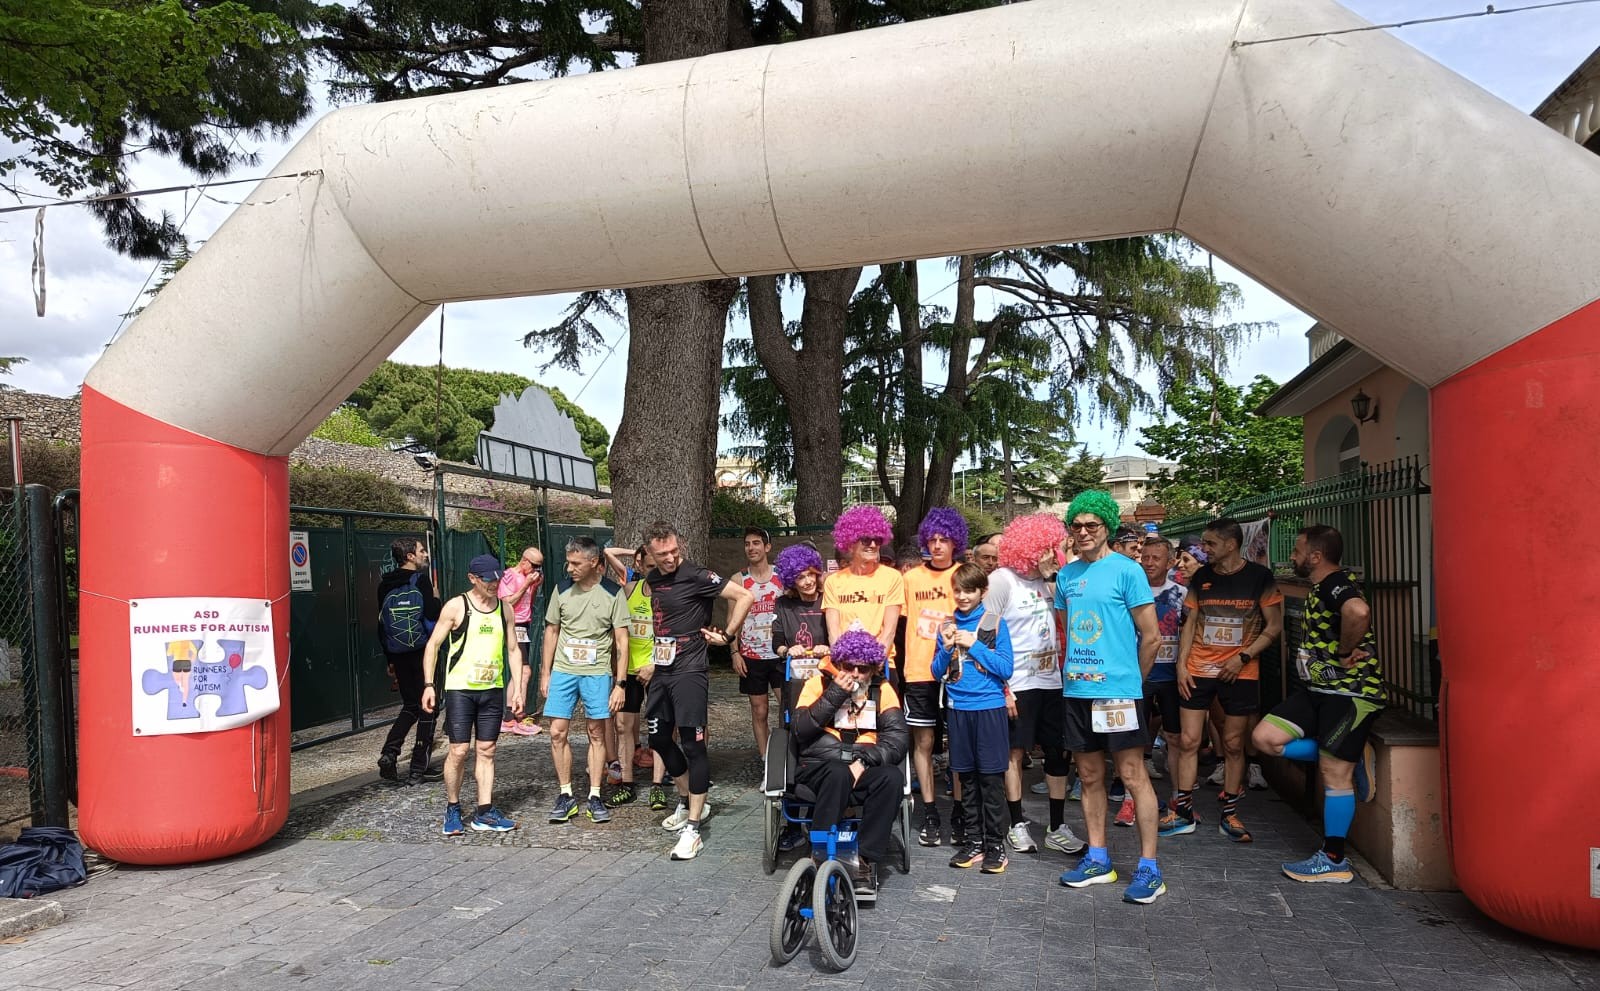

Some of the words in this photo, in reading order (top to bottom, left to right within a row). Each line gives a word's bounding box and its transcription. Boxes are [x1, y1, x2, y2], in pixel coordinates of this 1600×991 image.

[193, 610, 219, 619] ASD
[133, 624, 197, 634] RUNNERS
[200, 623, 226, 633] FOR
[228, 624, 270, 633] AUTISM
[633, 624, 647, 636] 18
[1215, 628, 1233, 641] 45
[572, 649, 589, 661] 52
[1073, 647, 1096, 657] Malta
[1039, 655, 1054, 671] 38
[1067, 655, 1104, 665] Marathon
[193, 666, 227, 674] RUNNERS
[193, 675, 208, 683] FOR
[193, 683, 221, 691] AUTISM
[1105, 711, 1126, 728] 50
